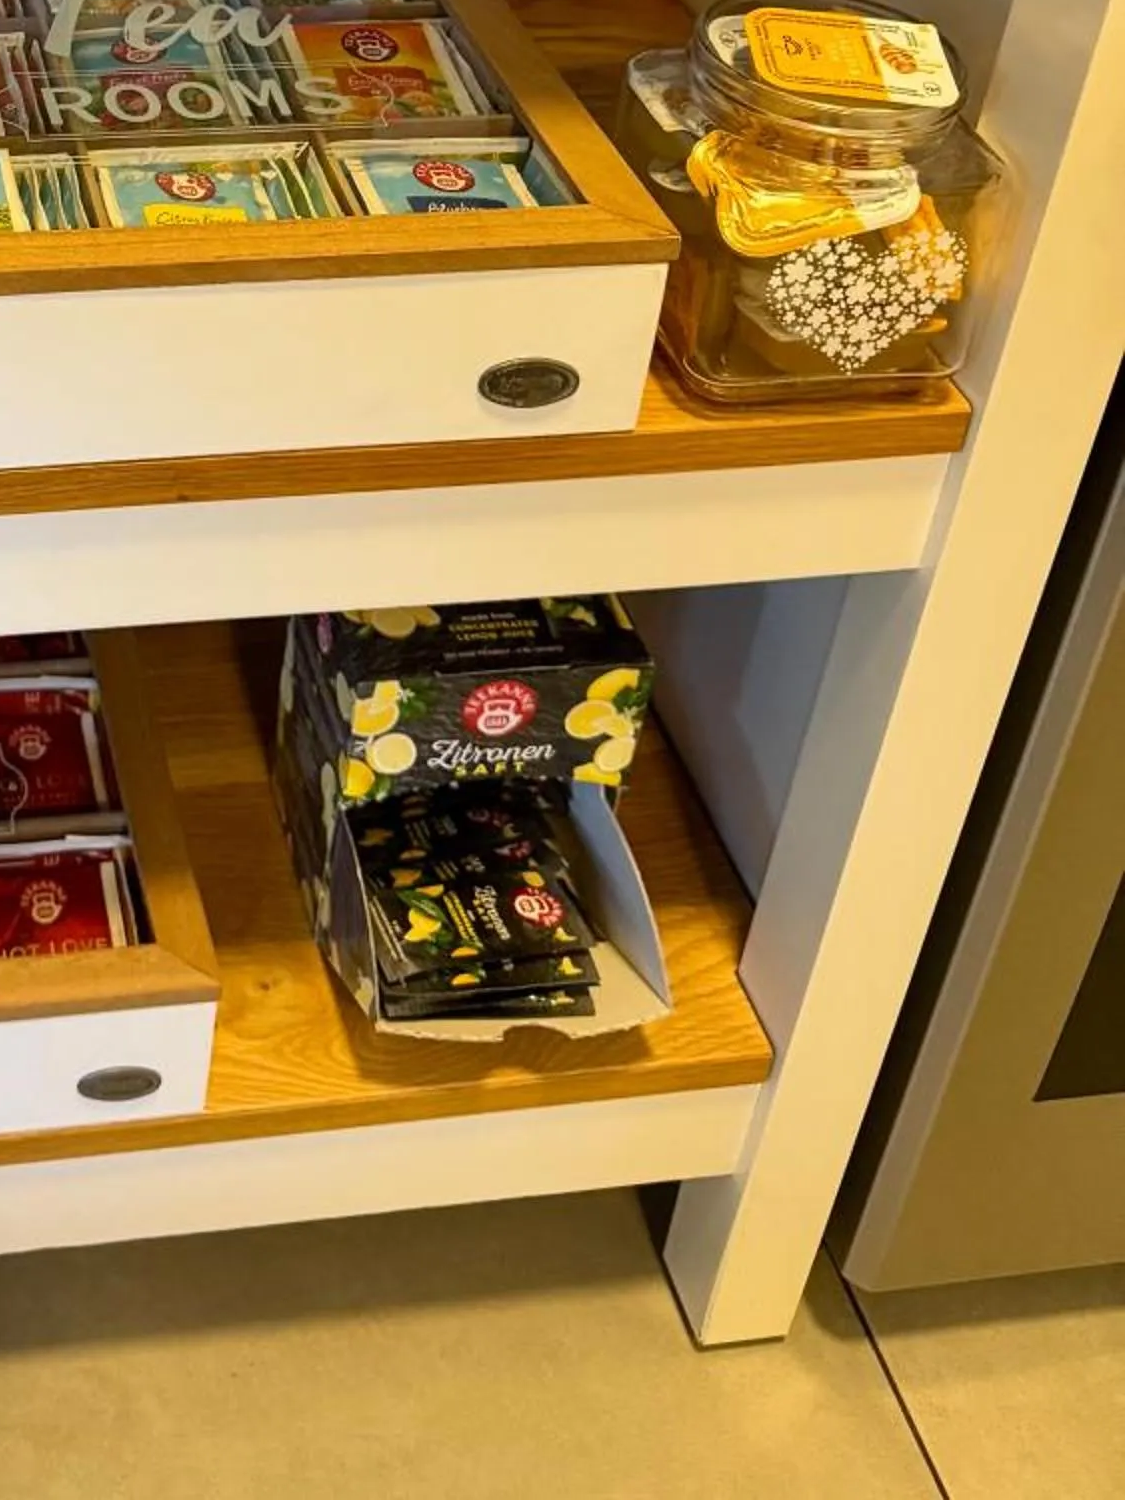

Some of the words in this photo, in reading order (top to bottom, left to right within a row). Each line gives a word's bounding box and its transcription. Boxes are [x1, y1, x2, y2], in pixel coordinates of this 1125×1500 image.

[41, 78, 353, 127] ROOMS
[464, 682, 536, 714] TEEKANNE
[427, 739, 555, 769] Zitronen
[455, 761, 525, 777] SAFT
[49, 937, 108, 958] LOVE
